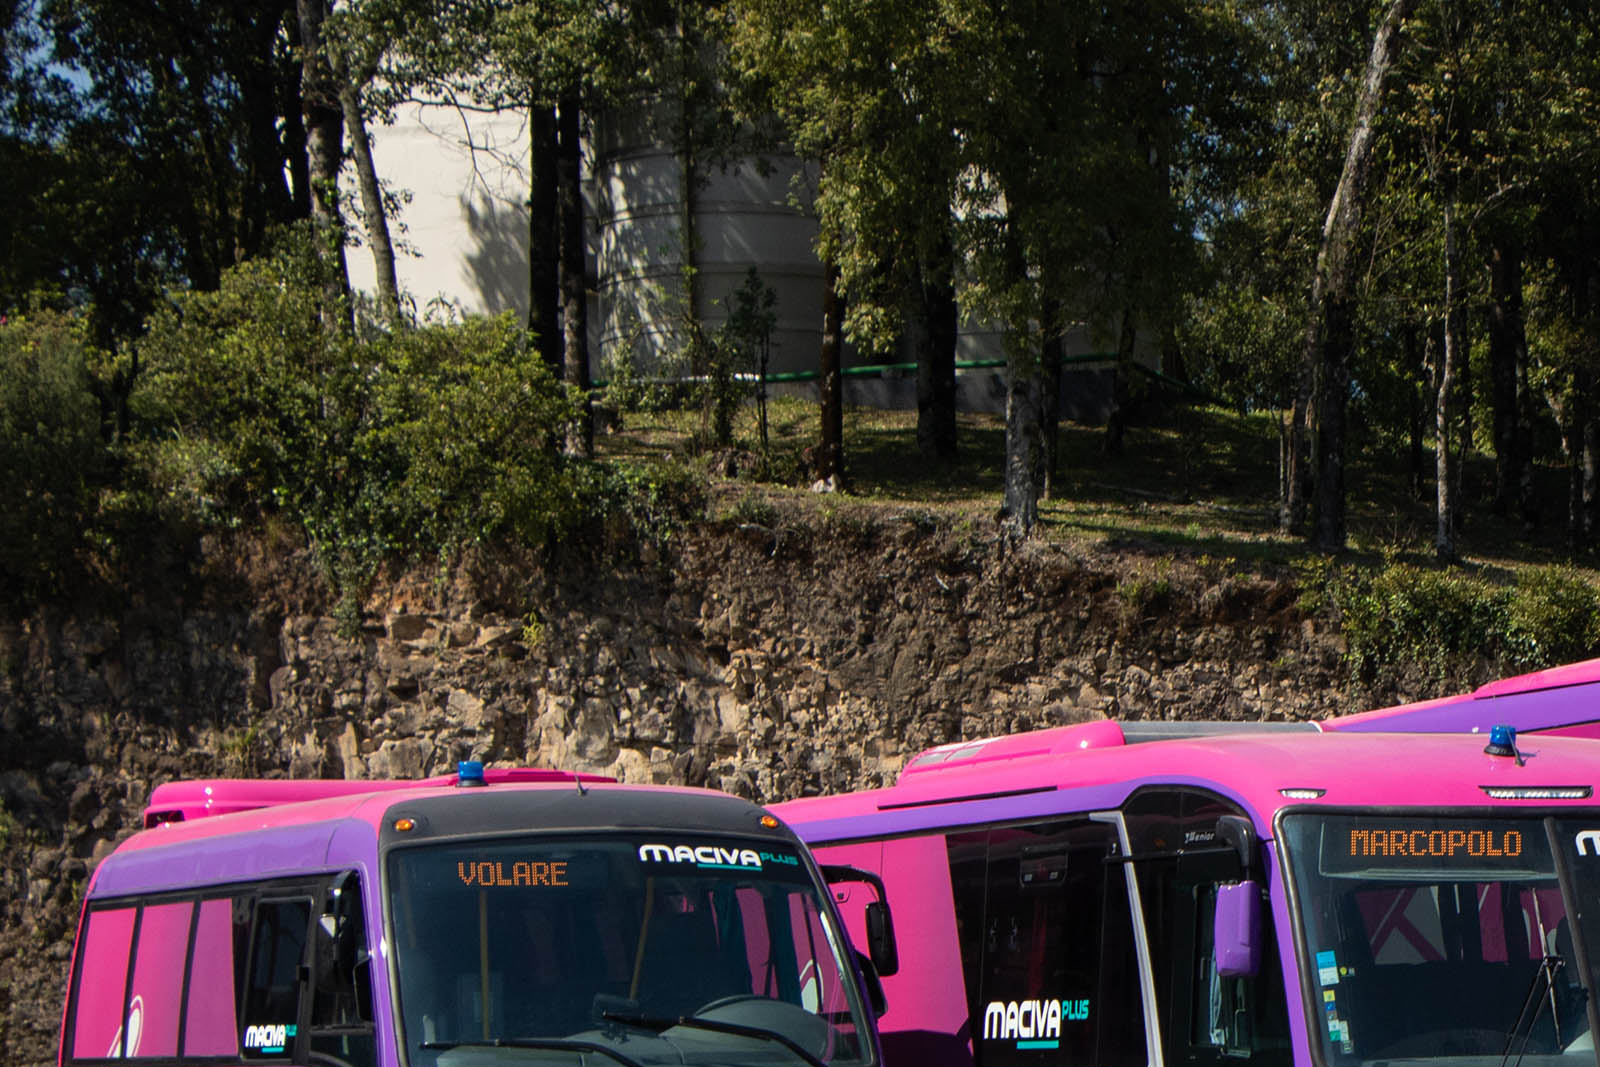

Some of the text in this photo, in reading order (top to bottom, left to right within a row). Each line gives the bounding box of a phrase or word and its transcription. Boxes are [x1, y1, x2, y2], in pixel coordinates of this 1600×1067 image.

[639, 844, 799, 867] MACIVA PLUS
[1349, 829, 1523, 857] MARCOPOLO
[457, 861, 569, 887] VOLARE
[983, 999, 1090, 1039] MACIVA PLUS
[244, 1024, 286, 1047] MACIVA
